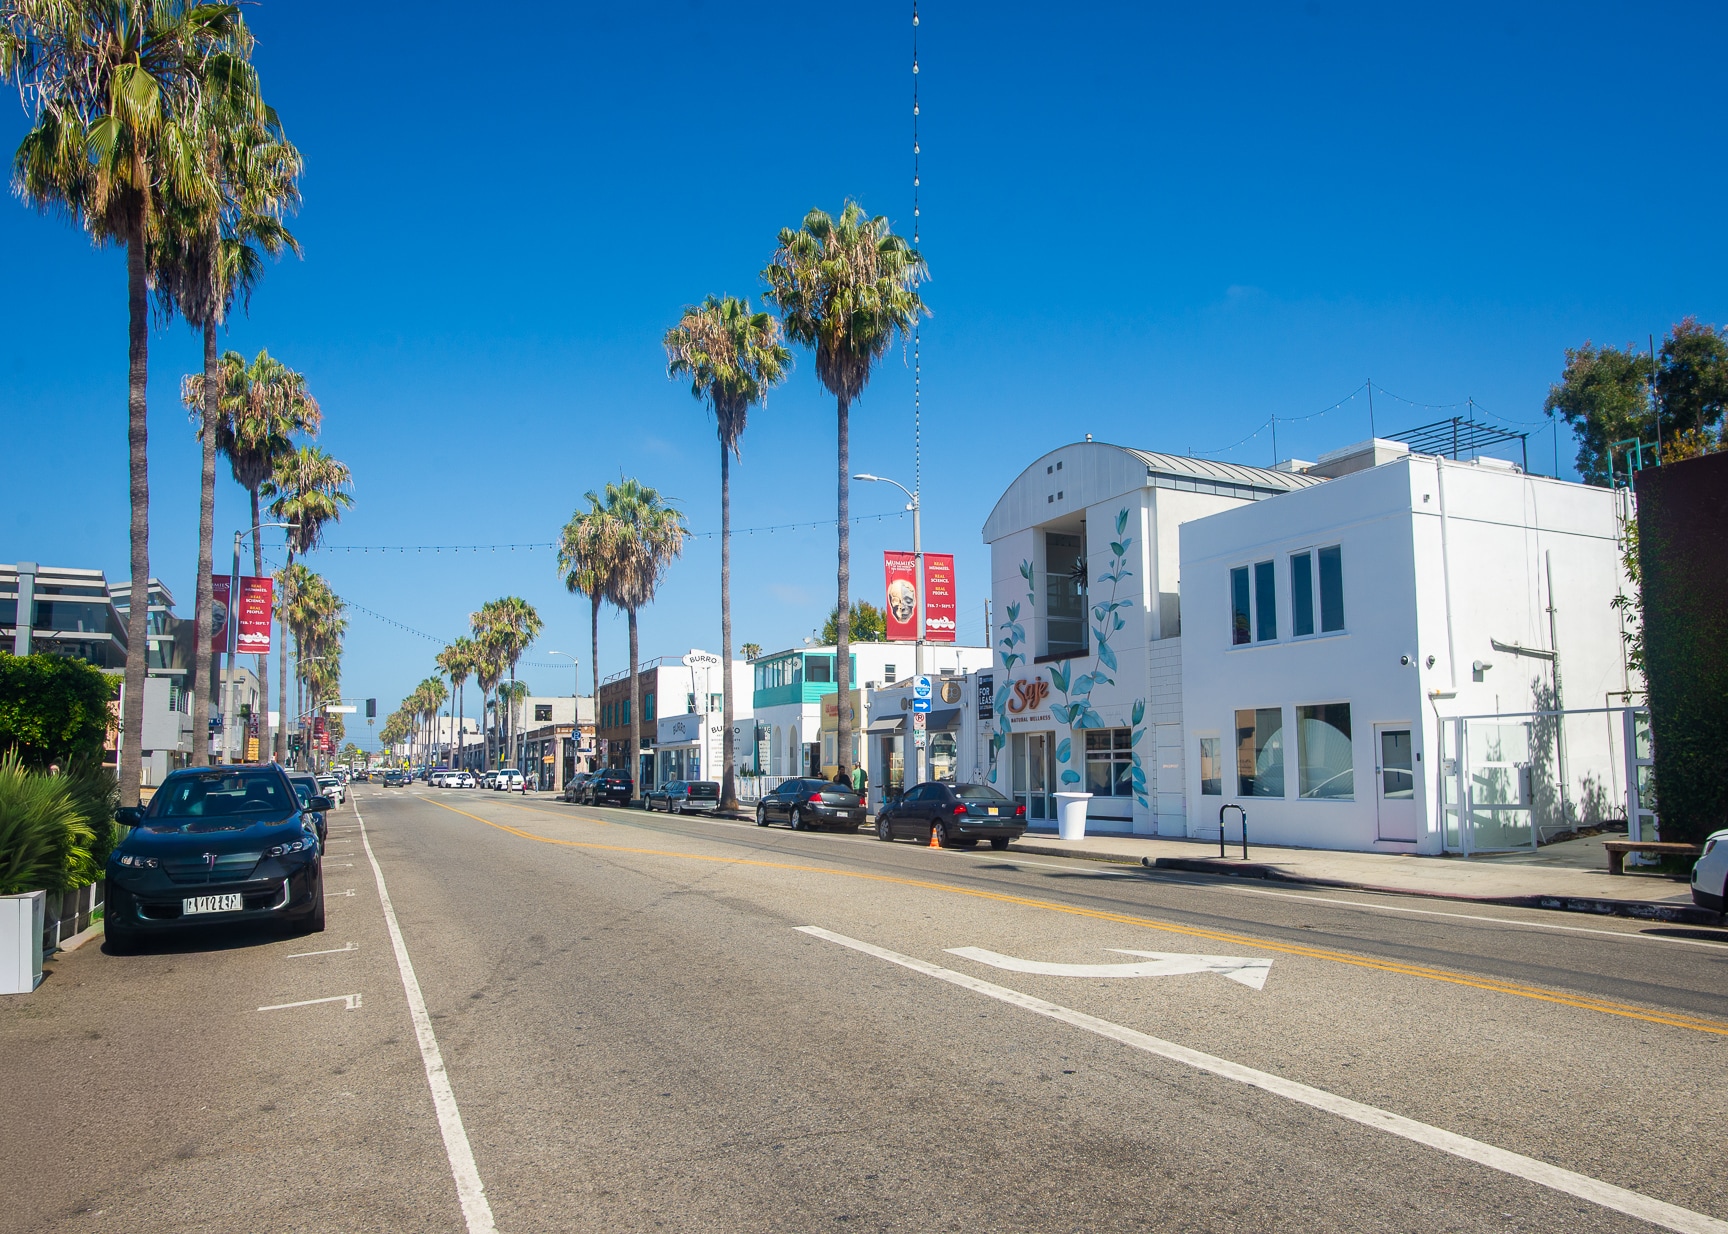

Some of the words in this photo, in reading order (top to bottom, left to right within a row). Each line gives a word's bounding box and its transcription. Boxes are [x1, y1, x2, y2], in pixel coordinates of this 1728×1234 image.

[689, 655, 718, 664] BURRO
[1008, 676, 1049, 713] Saje
[711, 725, 740, 734] BUO
